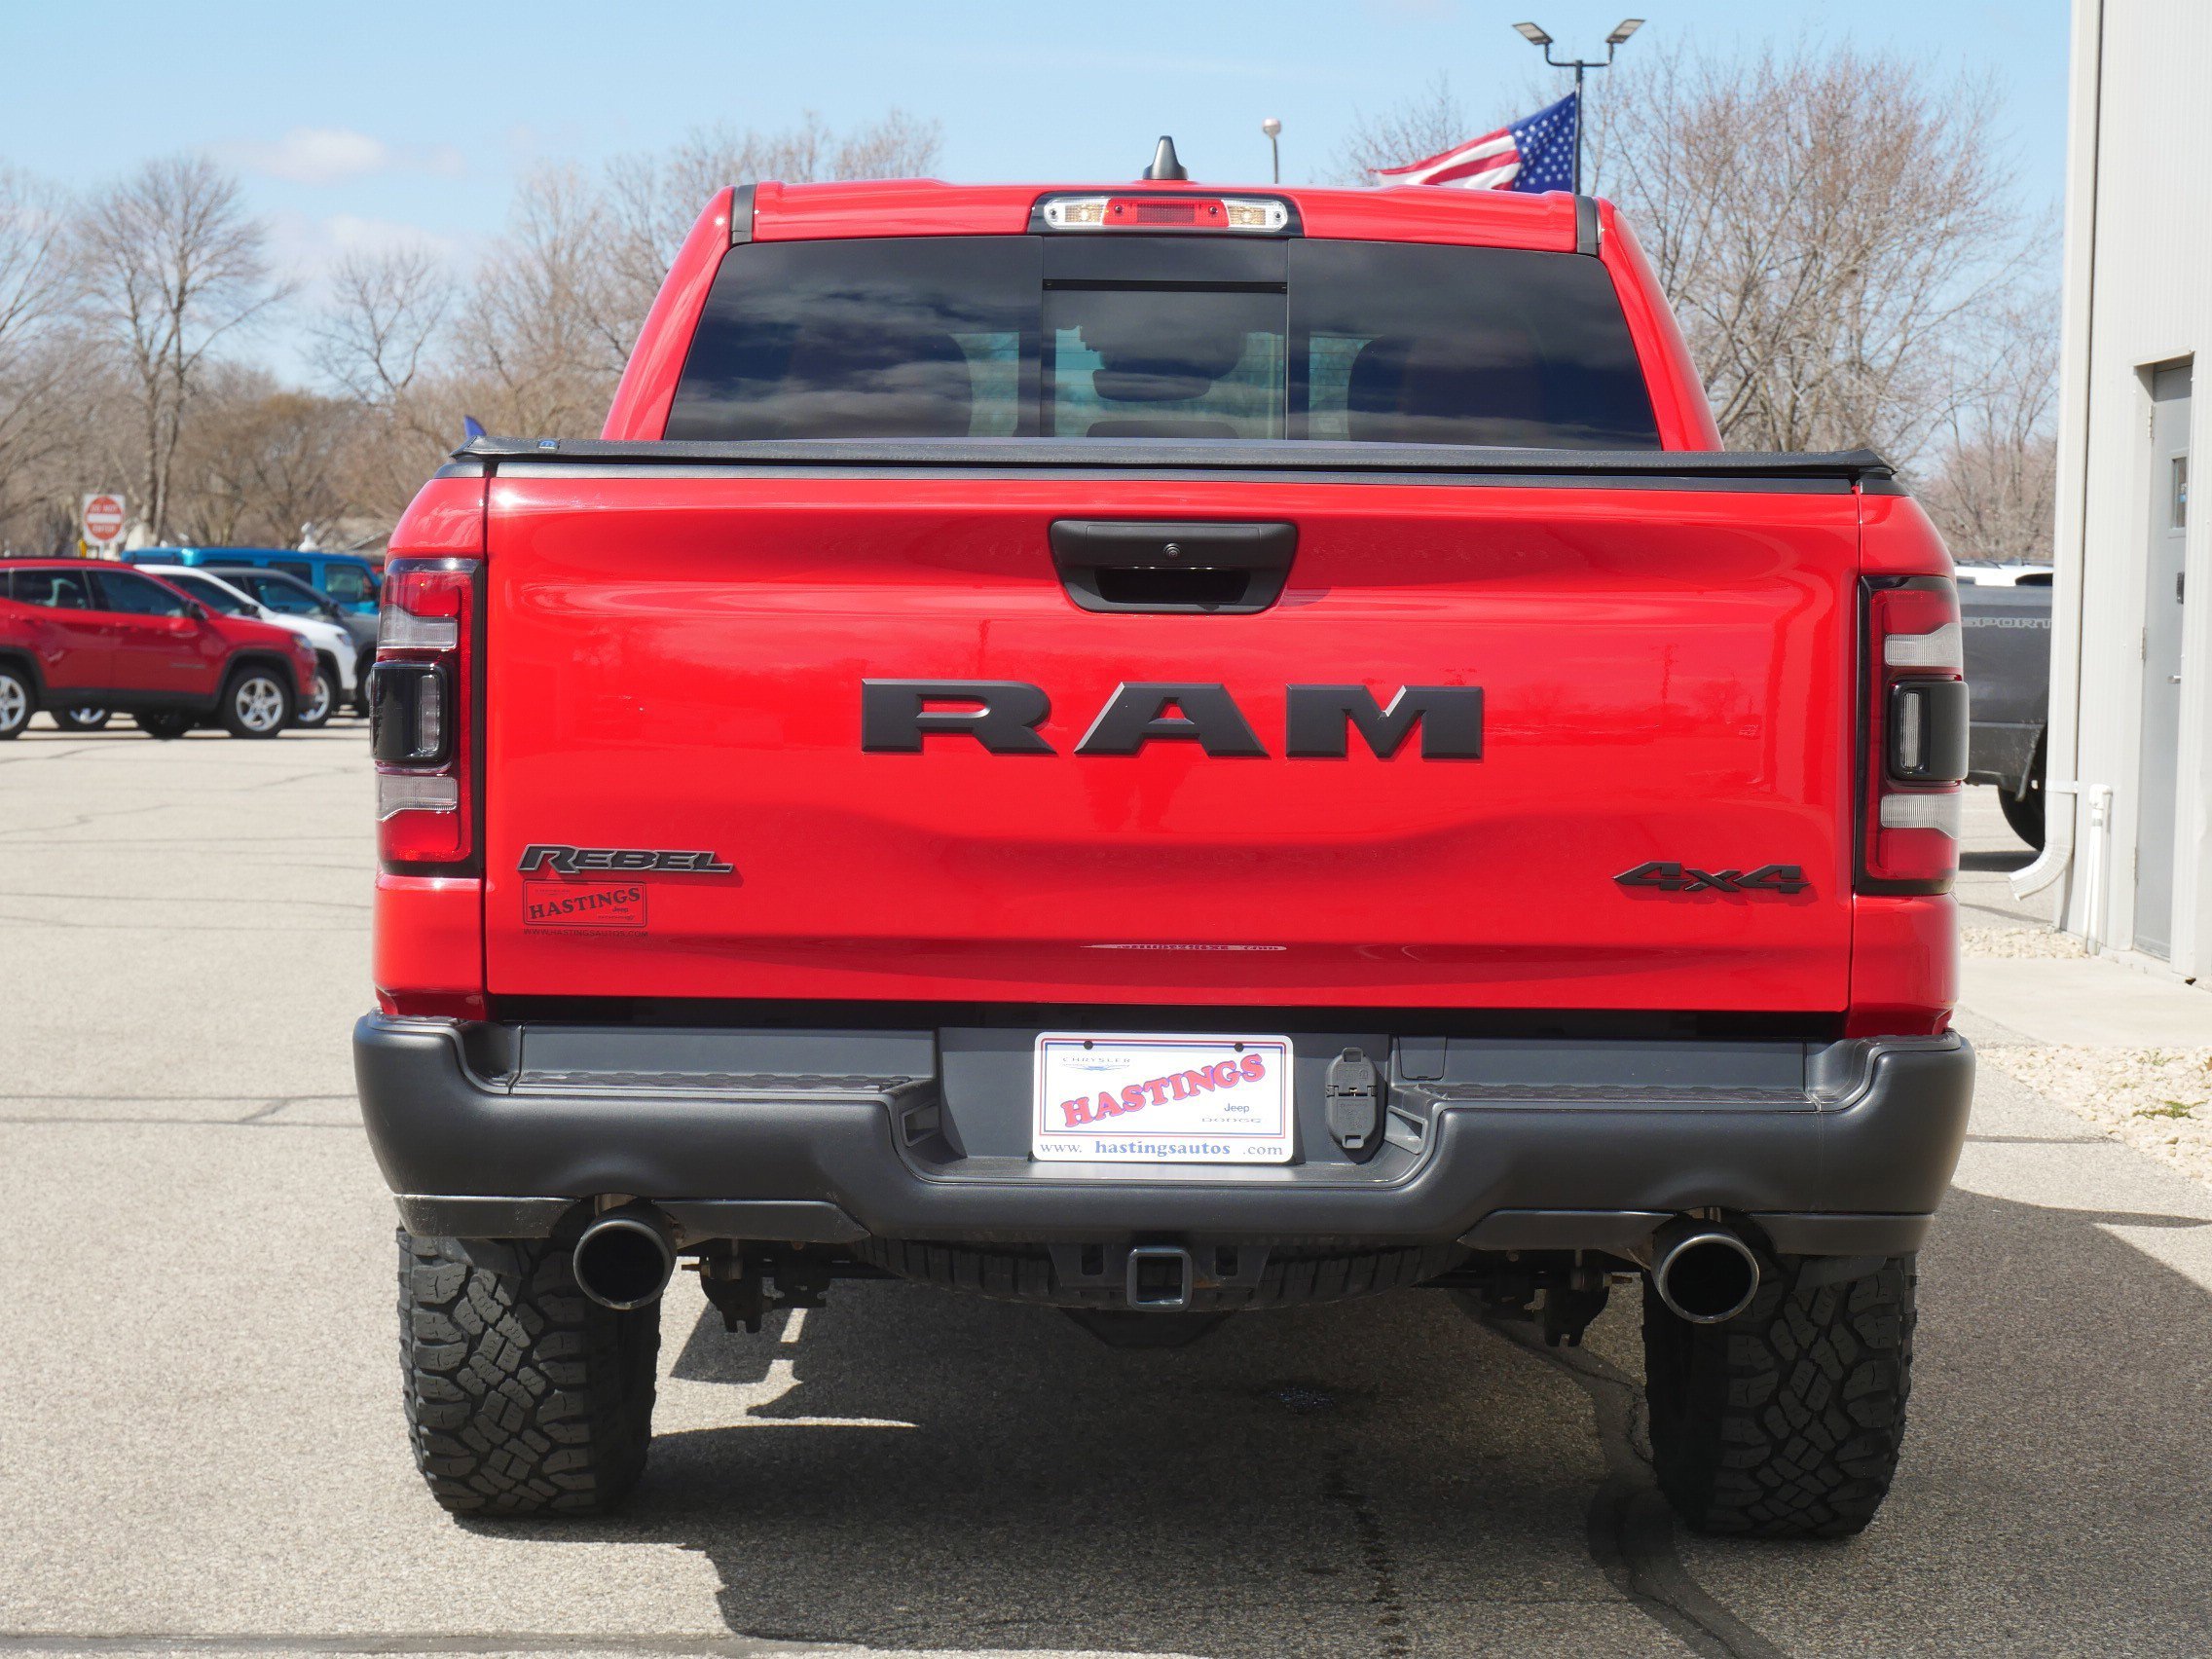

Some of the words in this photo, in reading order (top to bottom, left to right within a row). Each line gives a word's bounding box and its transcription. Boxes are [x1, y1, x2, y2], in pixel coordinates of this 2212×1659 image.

[862, 679, 1485, 759] RAM
[517, 843, 734, 873] REBEL
[529, 887, 642, 920] HASTINGS
[1059, 1053, 1267, 1128] HASTINGS
[1224, 1102, 1251, 1114] Jeep
[1041, 1143, 1083, 1153] www.
[1094, 1140, 1231, 1157] hastingsautos
[1242, 1145, 1283, 1156] .com
